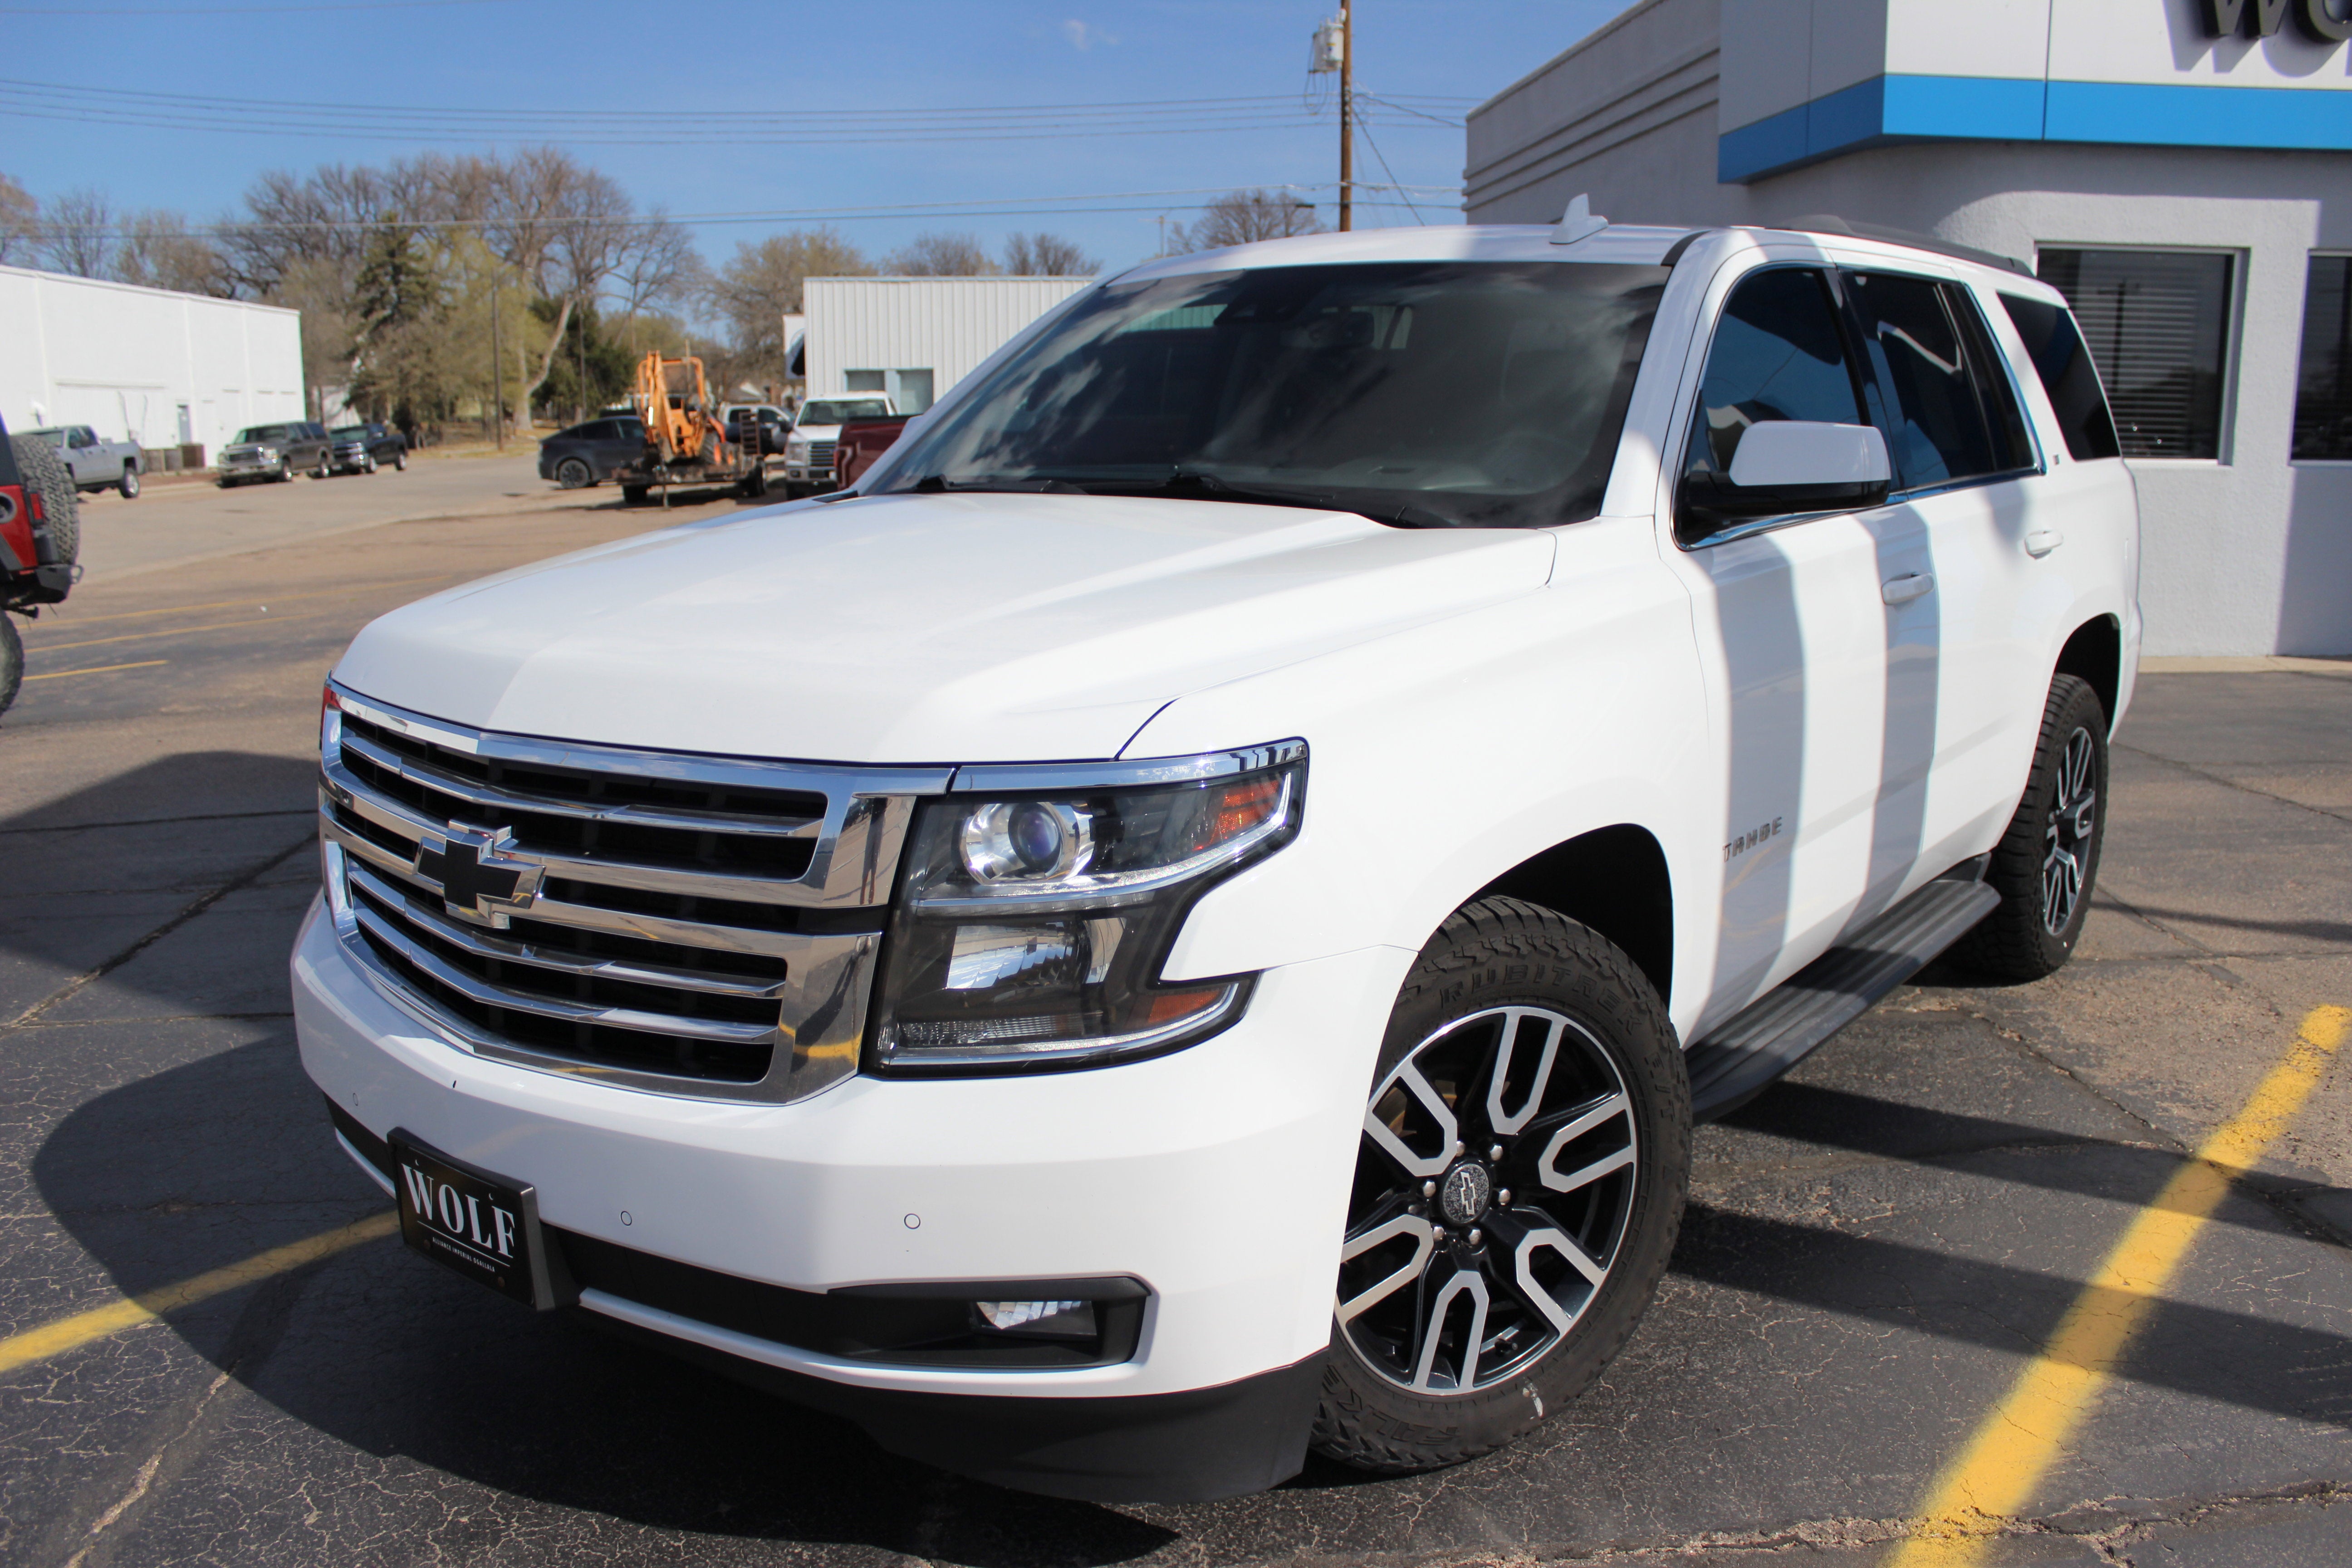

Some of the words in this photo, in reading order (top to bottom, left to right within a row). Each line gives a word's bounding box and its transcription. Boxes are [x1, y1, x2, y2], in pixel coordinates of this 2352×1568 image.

[1723, 816, 1783, 862] TAHOE
[1440, 964, 1644, 1035] RUBITREK
[402, 1163, 515, 1259] WOLF
[432, 1236, 451, 1251] ALLIANCE
[452, 1247, 472, 1261] IMPERIAL
[473, 1257, 495, 1272] OGALLALA
